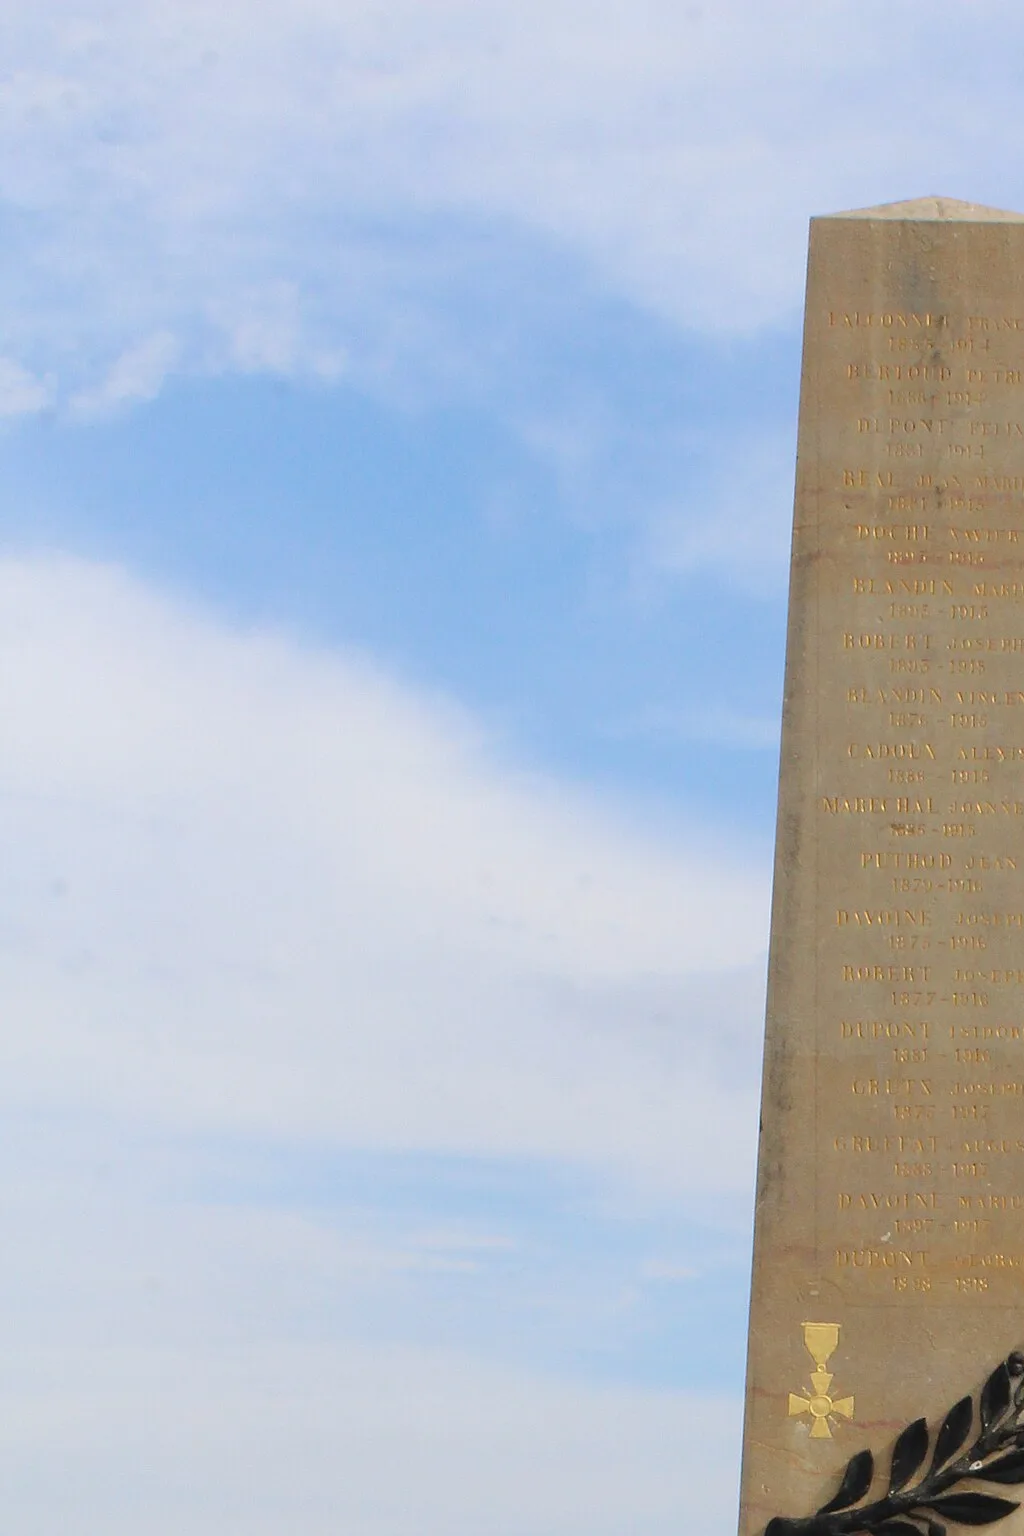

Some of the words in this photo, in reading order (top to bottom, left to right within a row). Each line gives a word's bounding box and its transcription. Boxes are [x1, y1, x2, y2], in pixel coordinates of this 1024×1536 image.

[853, 577, 954, 596] BLANDIN
[844, 632, 933, 650] ROBERT
[847, 686, 944, 704] BLANDIN
[860, 852, 953, 870] PUTHOD
[965, 855, 1019, 870] JEAN
[841, 965, 932, 983] ROBERT
[840, 1021, 932, 1039] DUPONT
[835, 1248, 931, 1267] DUPONT
